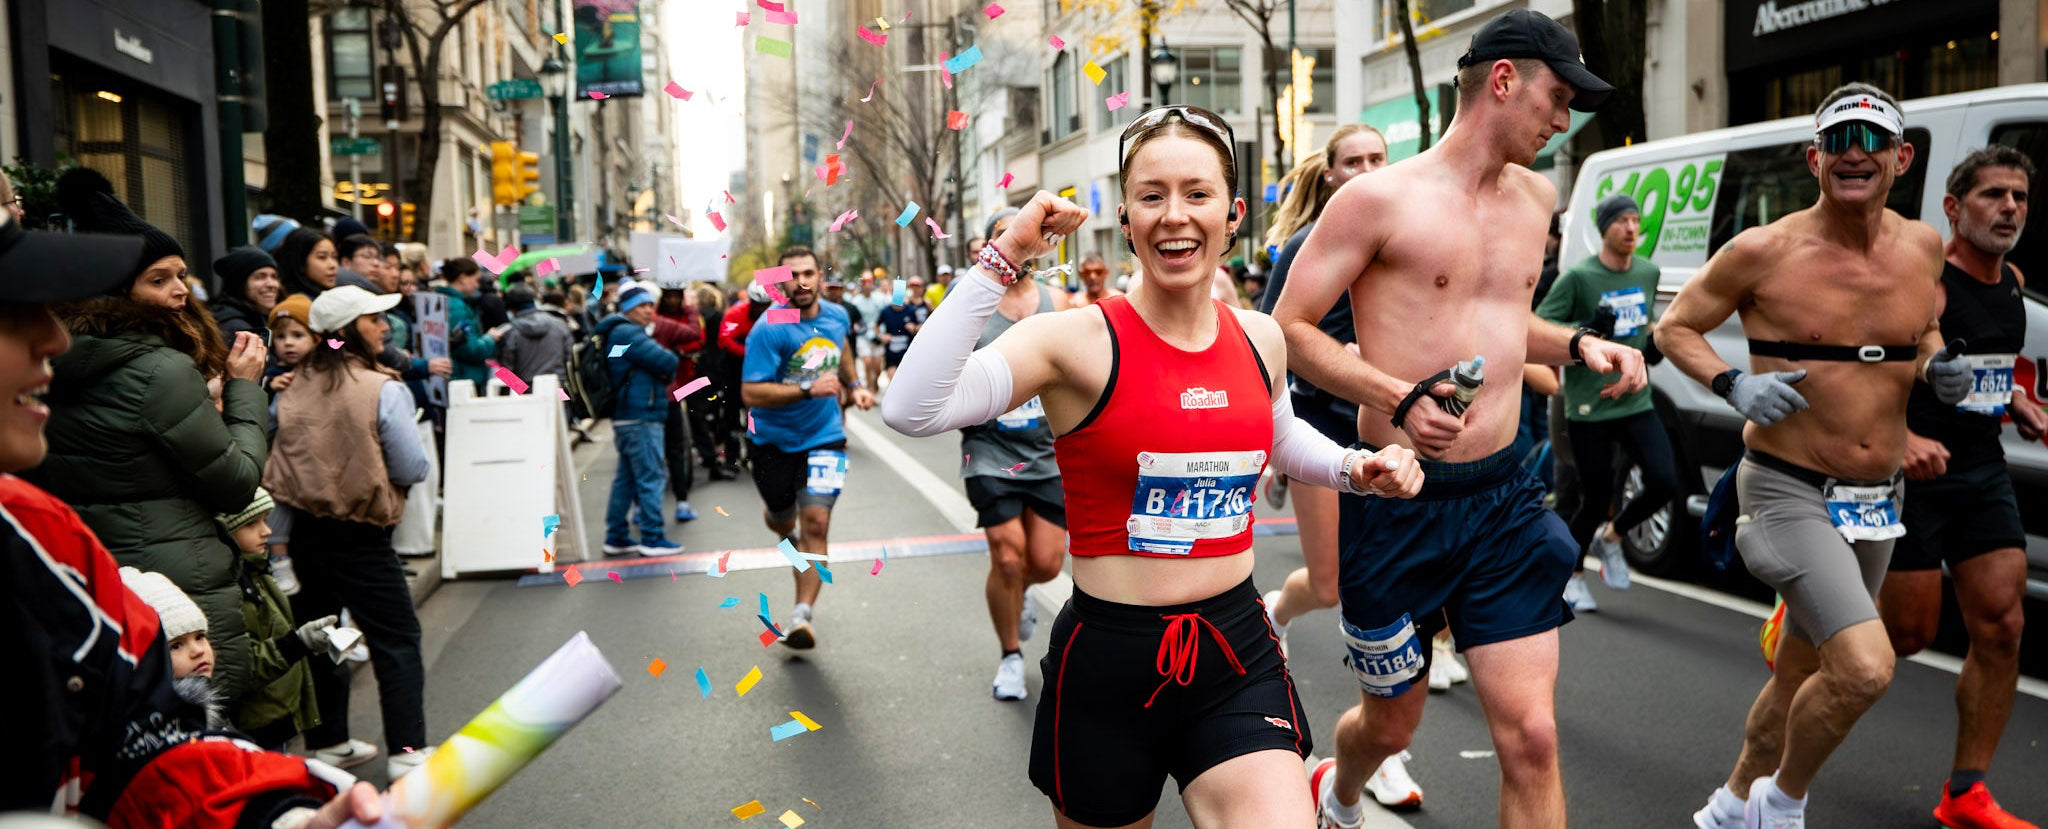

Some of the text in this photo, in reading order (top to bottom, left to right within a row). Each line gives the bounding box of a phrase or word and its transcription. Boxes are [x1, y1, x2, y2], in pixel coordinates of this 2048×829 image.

[1834, 98, 1884, 113] IRONMAN
[1662, 225, 1708, 241] IN-TOWN
[1182, 392, 1227, 407] Roadkill
[1186, 461, 1230, 473] MARATHON
[1194, 478, 1217, 488] Julia
[1145, 486, 1247, 518] B 11716
[1838, 508, 1854, 527] C
[1354, 642, 1389, 652] MARATHON
[1359, 646, 1417, 675] 11184
